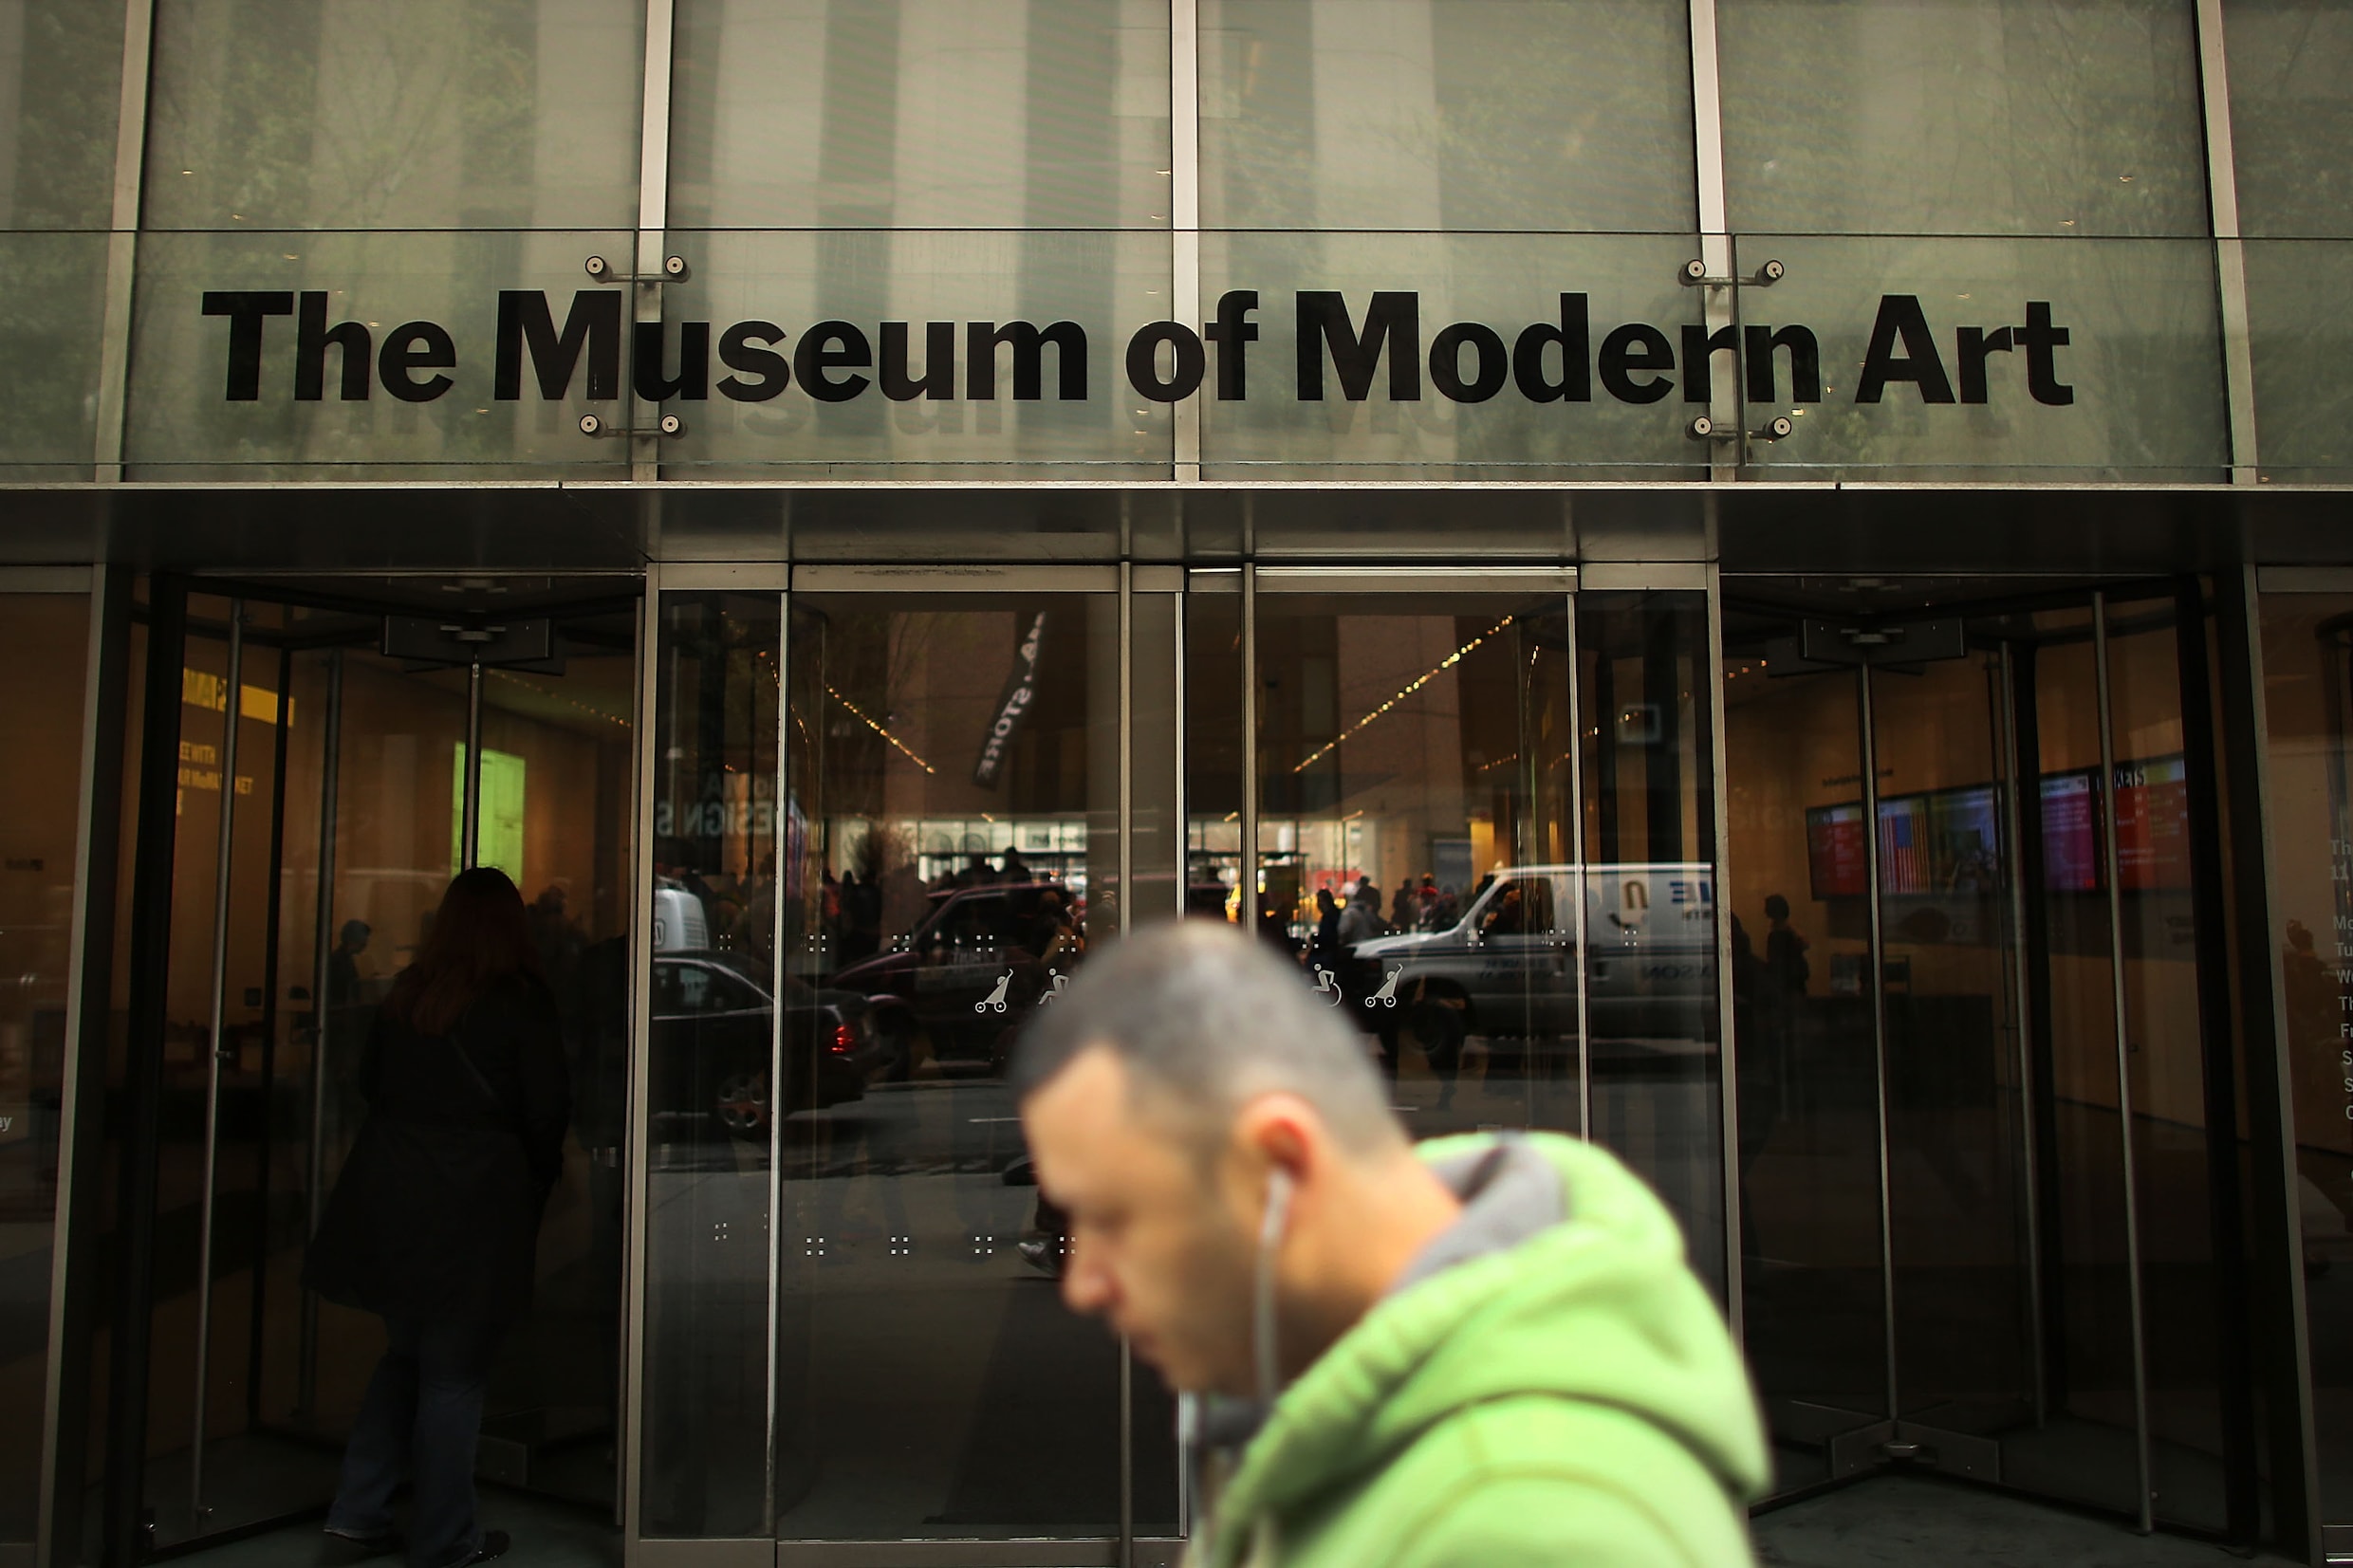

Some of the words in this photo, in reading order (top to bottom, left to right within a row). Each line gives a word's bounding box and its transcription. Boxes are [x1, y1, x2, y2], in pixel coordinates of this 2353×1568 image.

[202, 290, 456, 403] The
[494, 289, 1088, 403] Museum
[1125, 290, 1259, 403] of
[1296, 291, 1821, 405] Modern
[1854, 294, 2075, 407] Art
